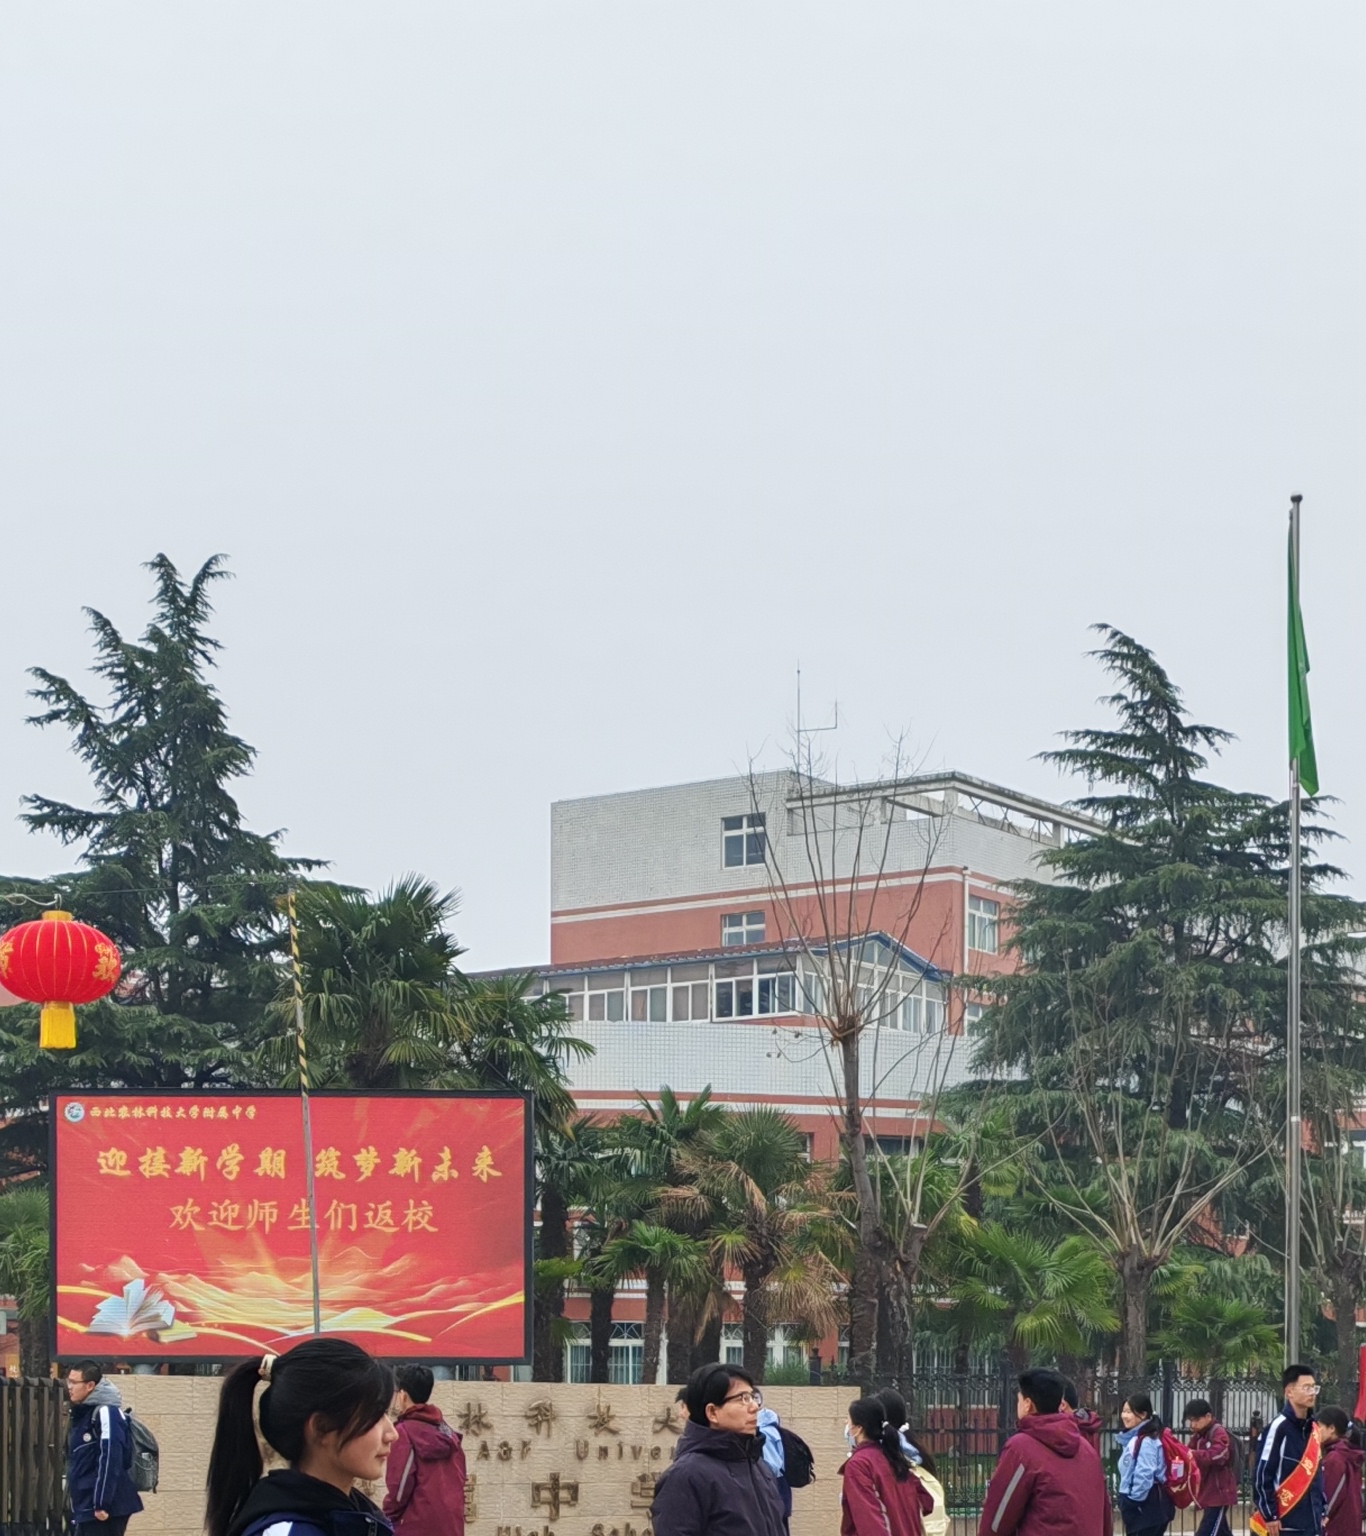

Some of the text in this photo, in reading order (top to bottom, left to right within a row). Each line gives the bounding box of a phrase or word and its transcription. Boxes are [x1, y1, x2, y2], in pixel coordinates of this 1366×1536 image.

[89, 1104, 257, 1120] 西北农林科技大学附属中学
[97, 1143, 503, 1183] 迎接新学期 筑梦新未来
[168, 1198, 439, 1234] 欢迎师生们返校
